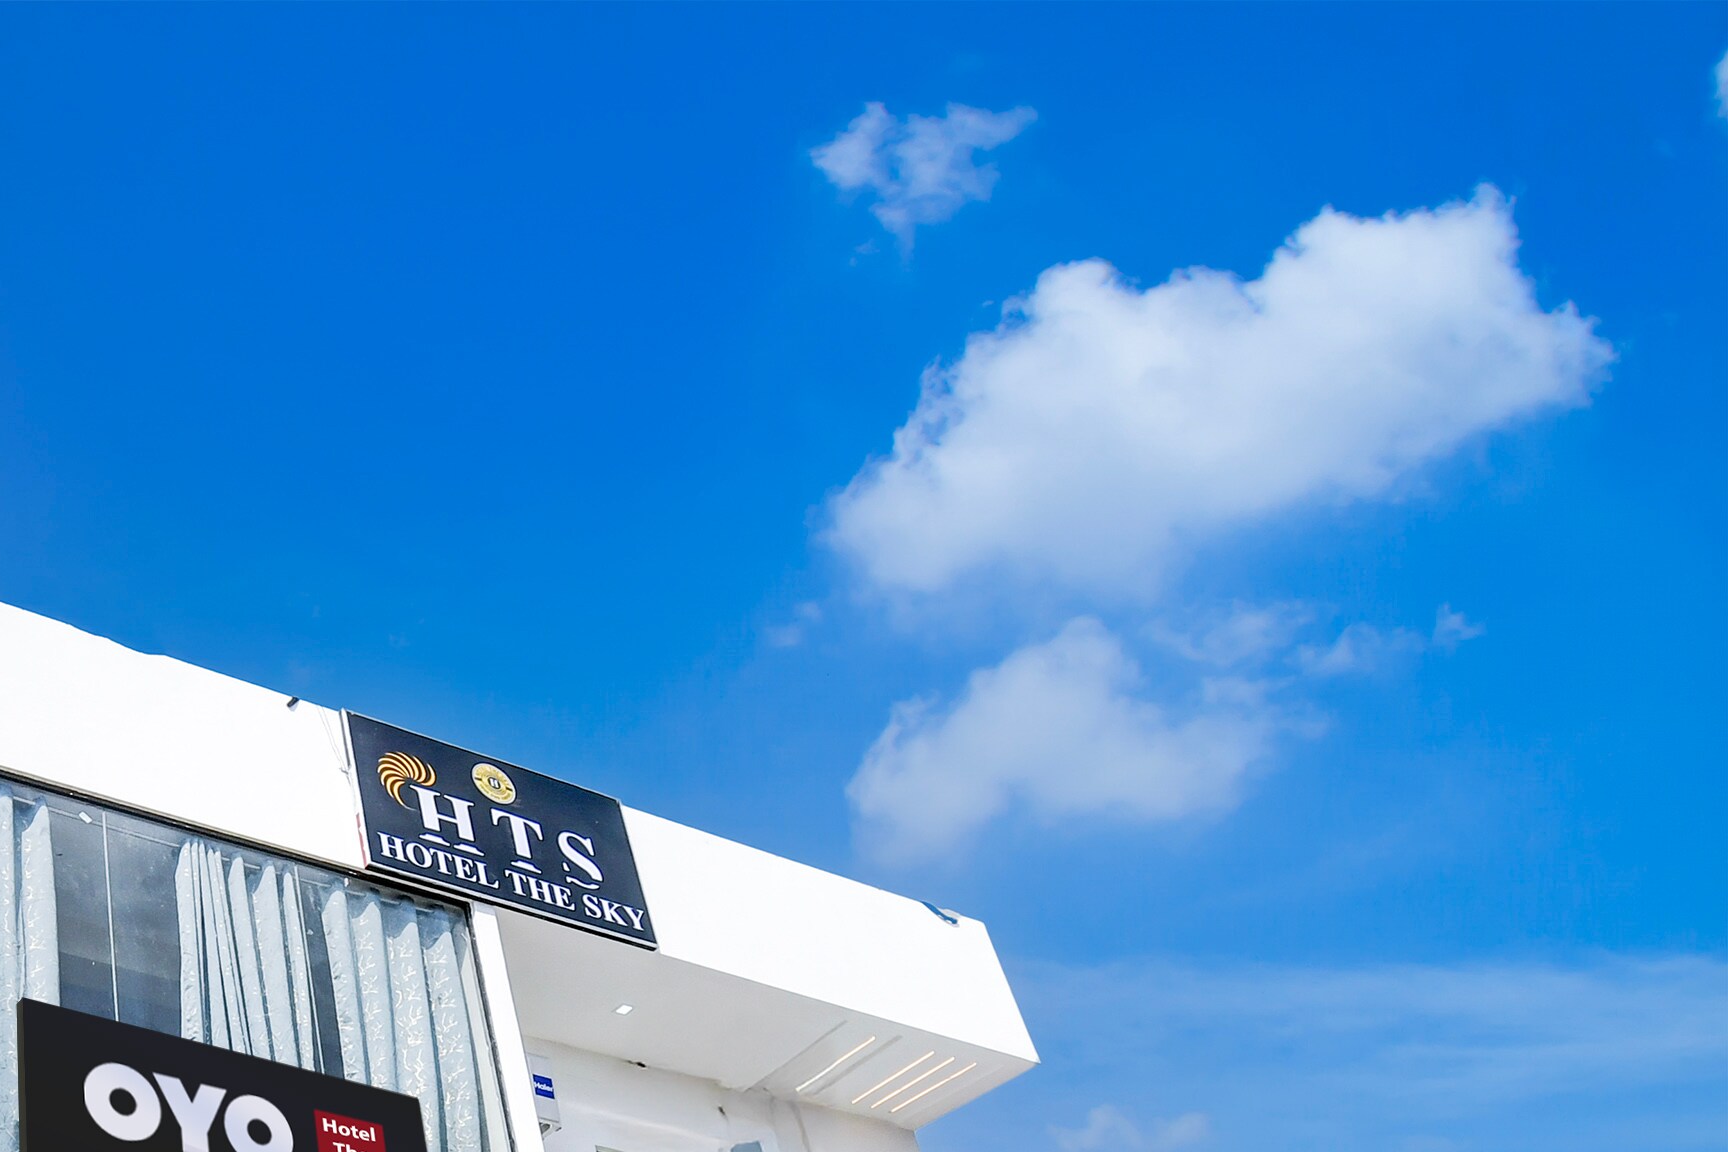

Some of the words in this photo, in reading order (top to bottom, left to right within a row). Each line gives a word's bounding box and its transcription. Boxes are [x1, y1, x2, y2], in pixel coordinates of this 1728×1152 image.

[377, 831, 499, 890] HOTEL
[504, 868, 576, 912] THE
[582, 893, 645, 932] SKY
[321, 1117, 377, 1143] Hotel
